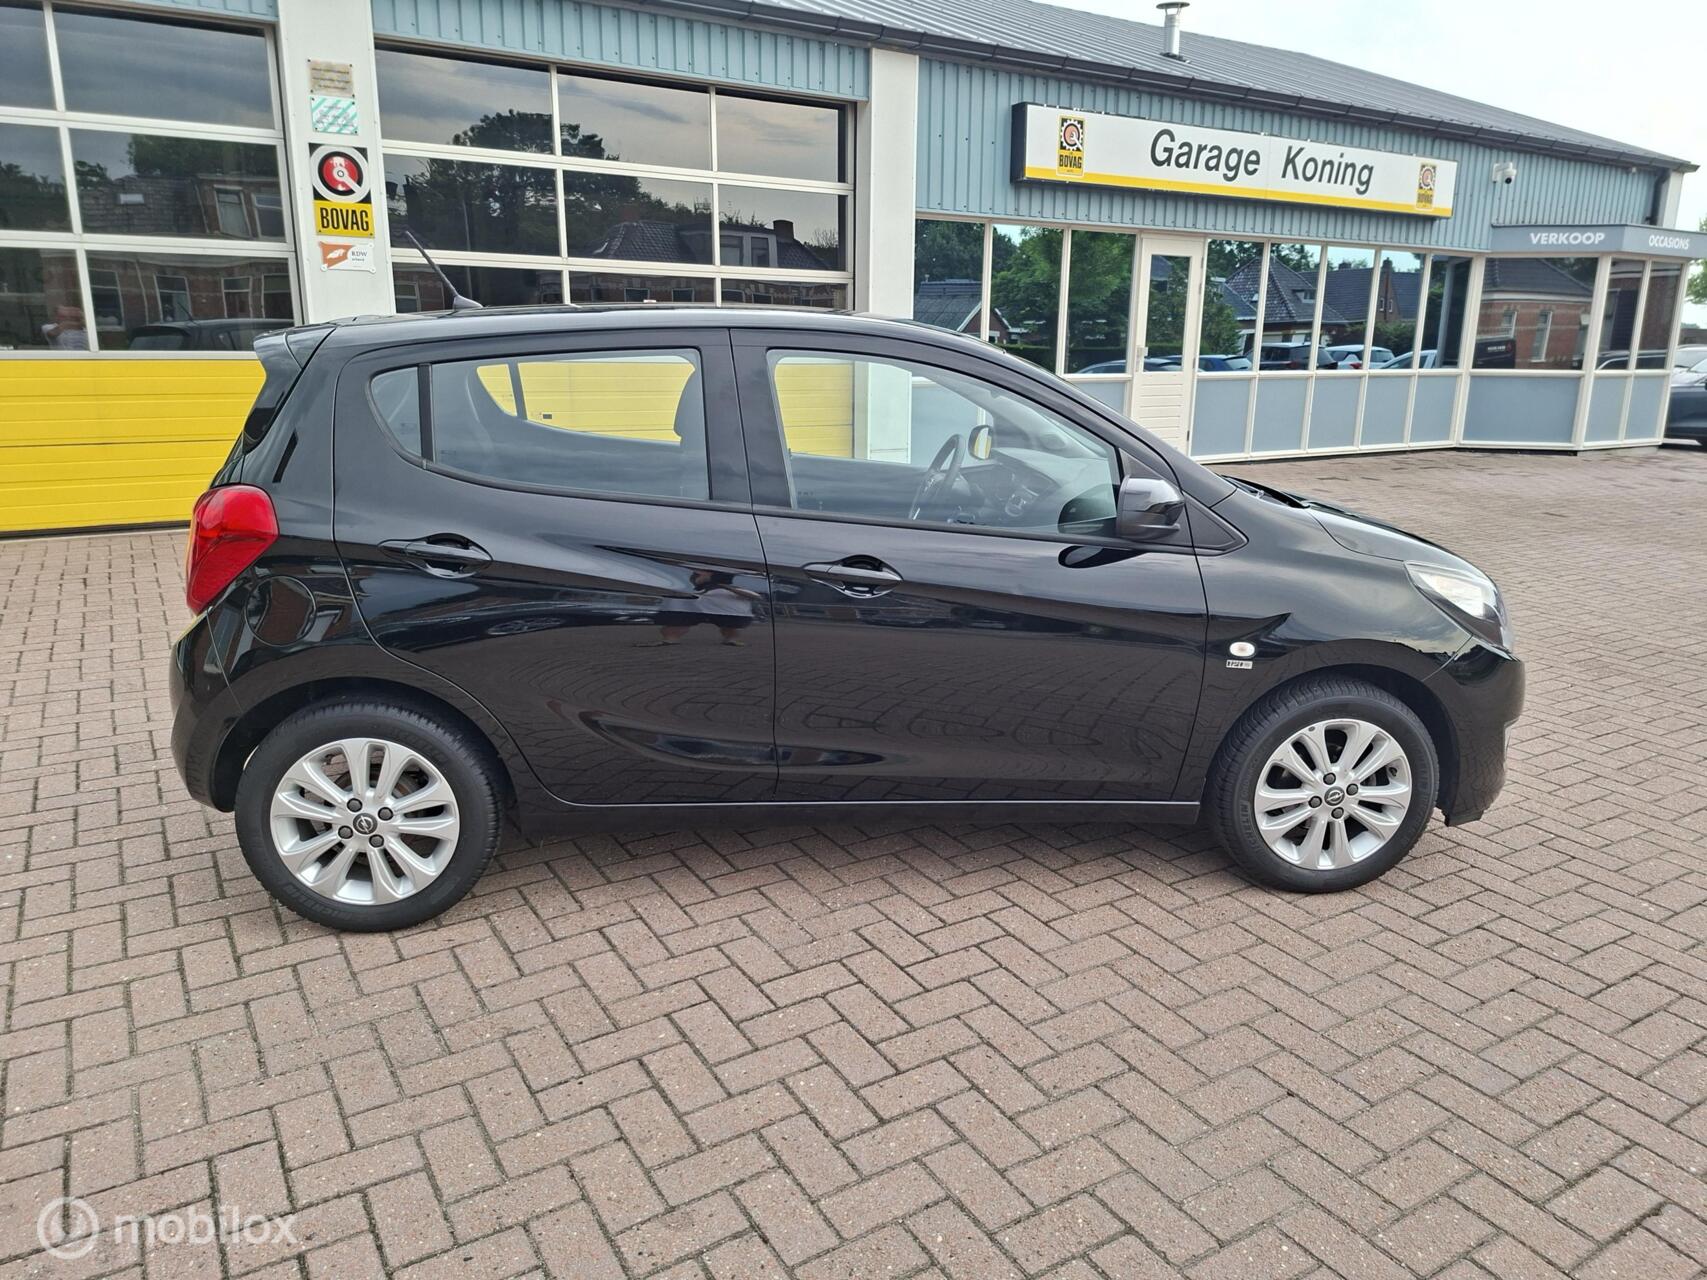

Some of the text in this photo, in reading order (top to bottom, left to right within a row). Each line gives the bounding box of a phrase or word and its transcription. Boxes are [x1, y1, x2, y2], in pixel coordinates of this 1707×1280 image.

[1059, 154, 1082, 168] BOVAG
[1150, 128, 1375, 195] Garage Koning
[320, 207, 369, 231] BOVAG
[1530, 232, 1605, 245] VERKOOP
[1648, 234, 1690, 250] OCCASIONS
